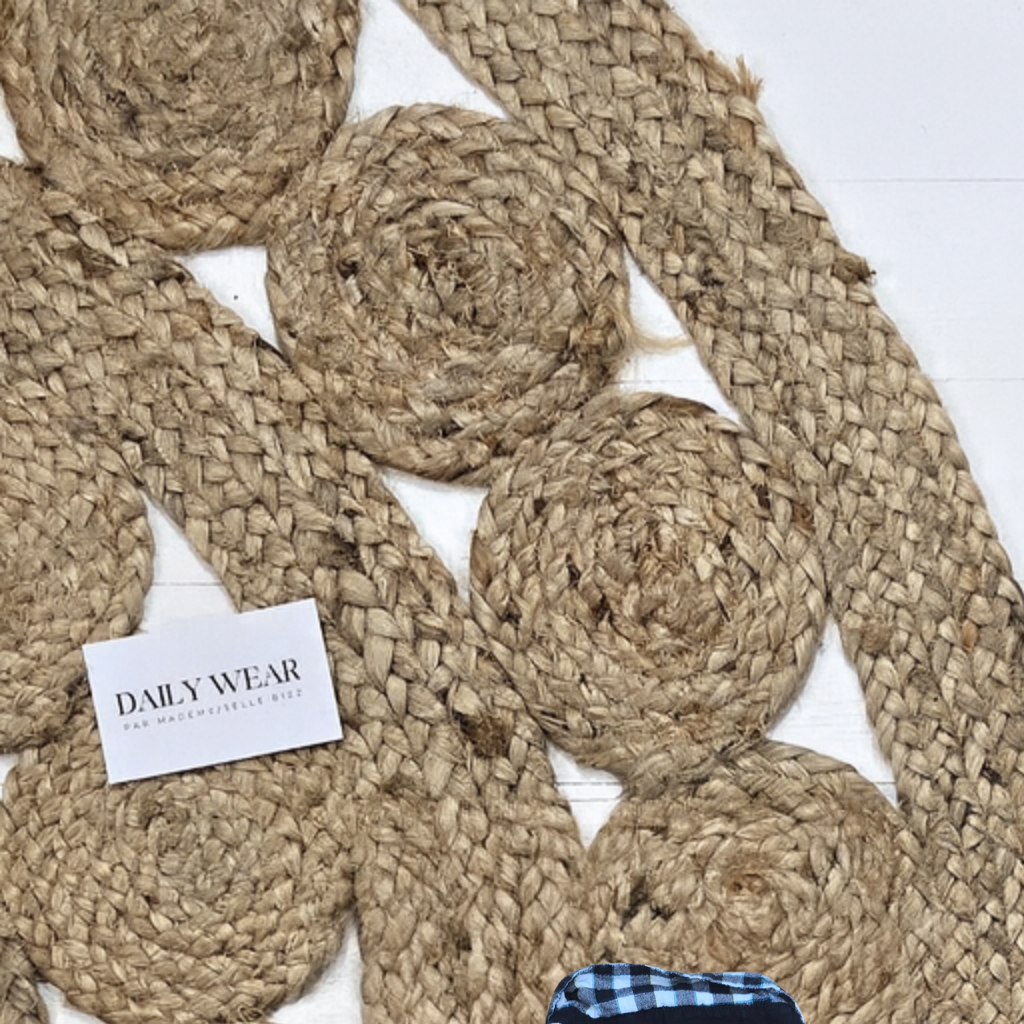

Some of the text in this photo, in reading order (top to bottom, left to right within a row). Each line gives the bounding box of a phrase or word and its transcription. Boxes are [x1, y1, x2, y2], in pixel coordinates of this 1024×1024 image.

[115, 658, 301, 716] DAILY WEAR
[123, 719, 150, 731] PAR
